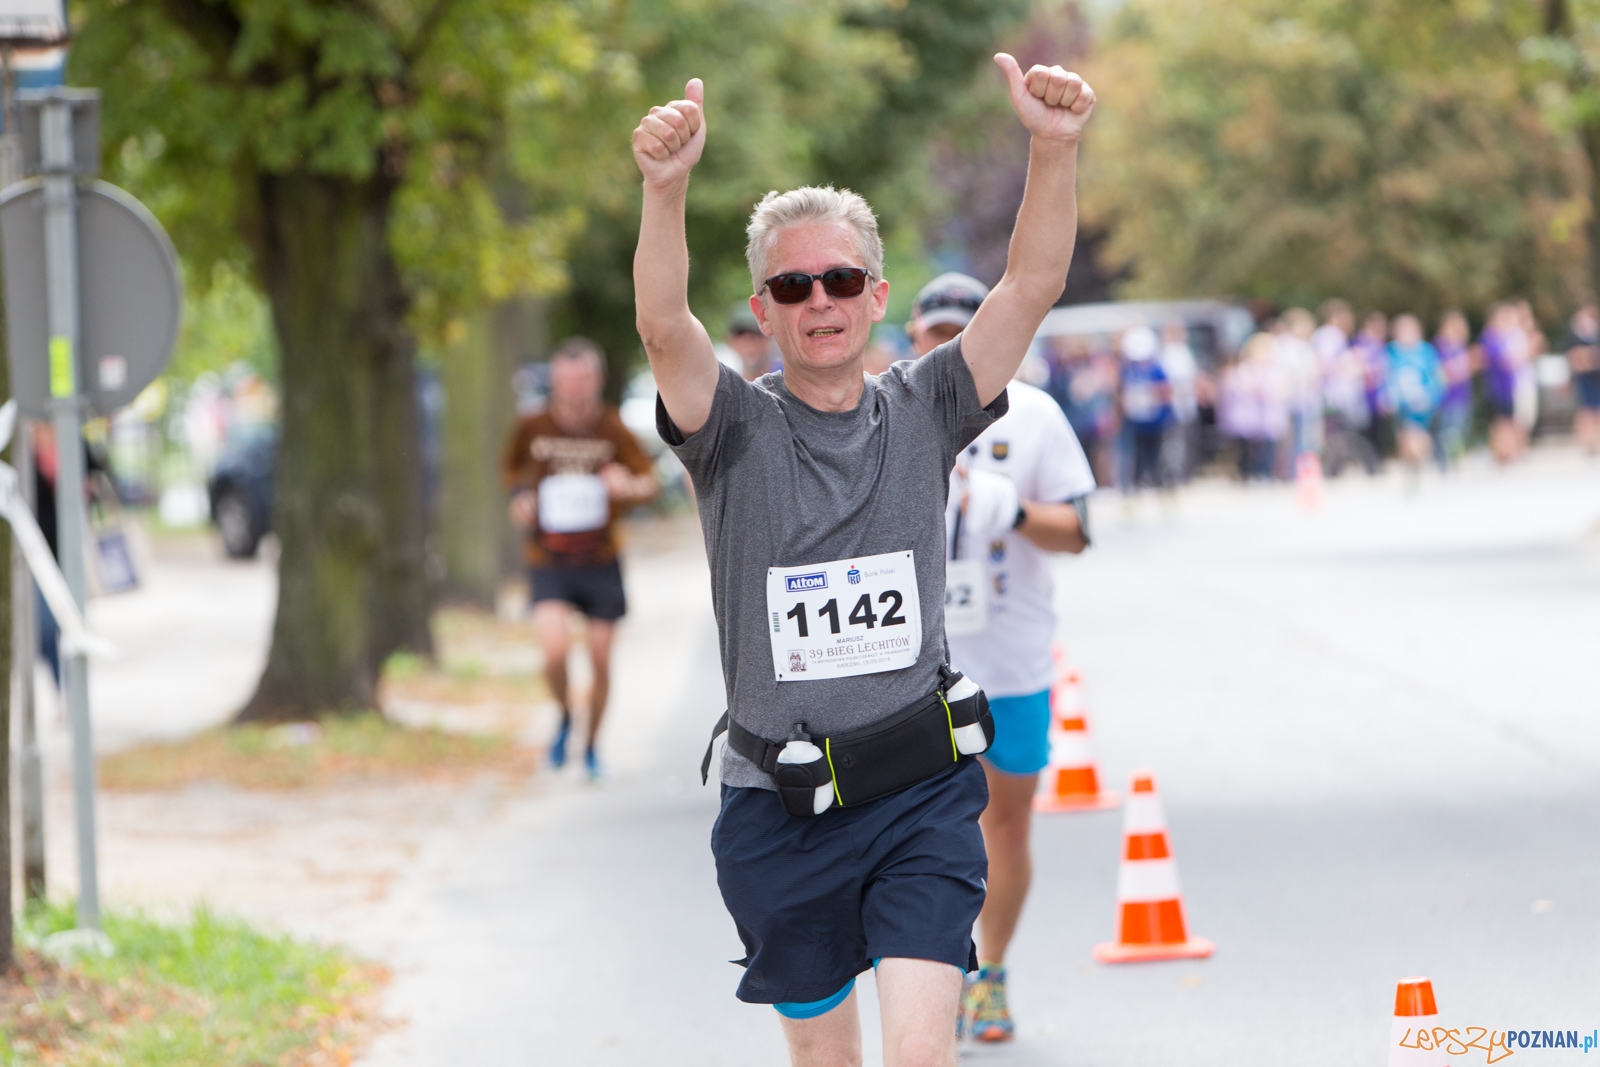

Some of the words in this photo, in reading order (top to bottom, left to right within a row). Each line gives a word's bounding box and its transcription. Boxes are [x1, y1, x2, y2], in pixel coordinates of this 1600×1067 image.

[880, 567, 896, 575] Polski
[787, 589, 906, 637] 1142
[809, 649, 823, 659] 39
[827, 645, 854, 657] BIEG
[858, 635, 911, 653] LECHITÓW
[836, 635, 864, 644] MARIUSZ
